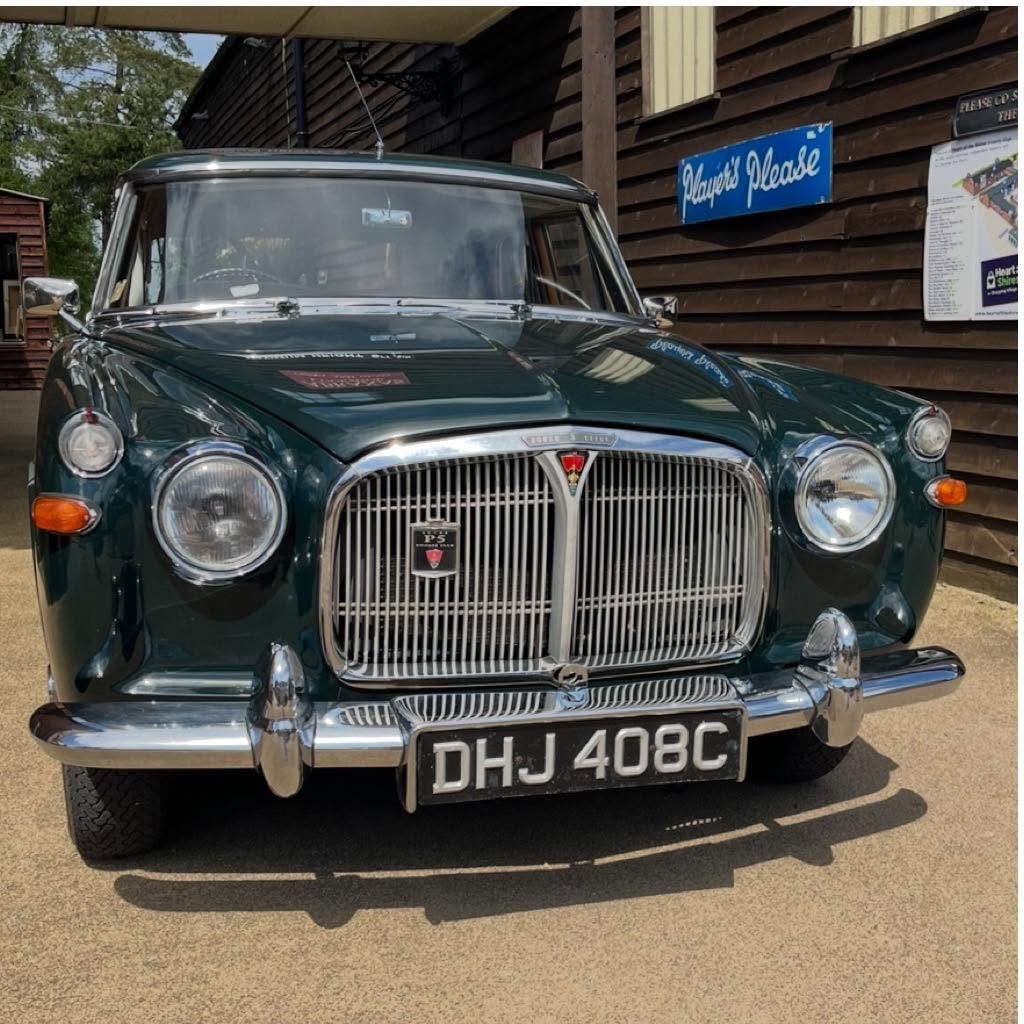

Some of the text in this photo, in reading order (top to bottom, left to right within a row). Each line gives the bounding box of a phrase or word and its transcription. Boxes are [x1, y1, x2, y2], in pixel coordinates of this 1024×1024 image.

[682, 145, 821, 219] Player's Please
[433, 721, 730, 795] DHJ 408C
